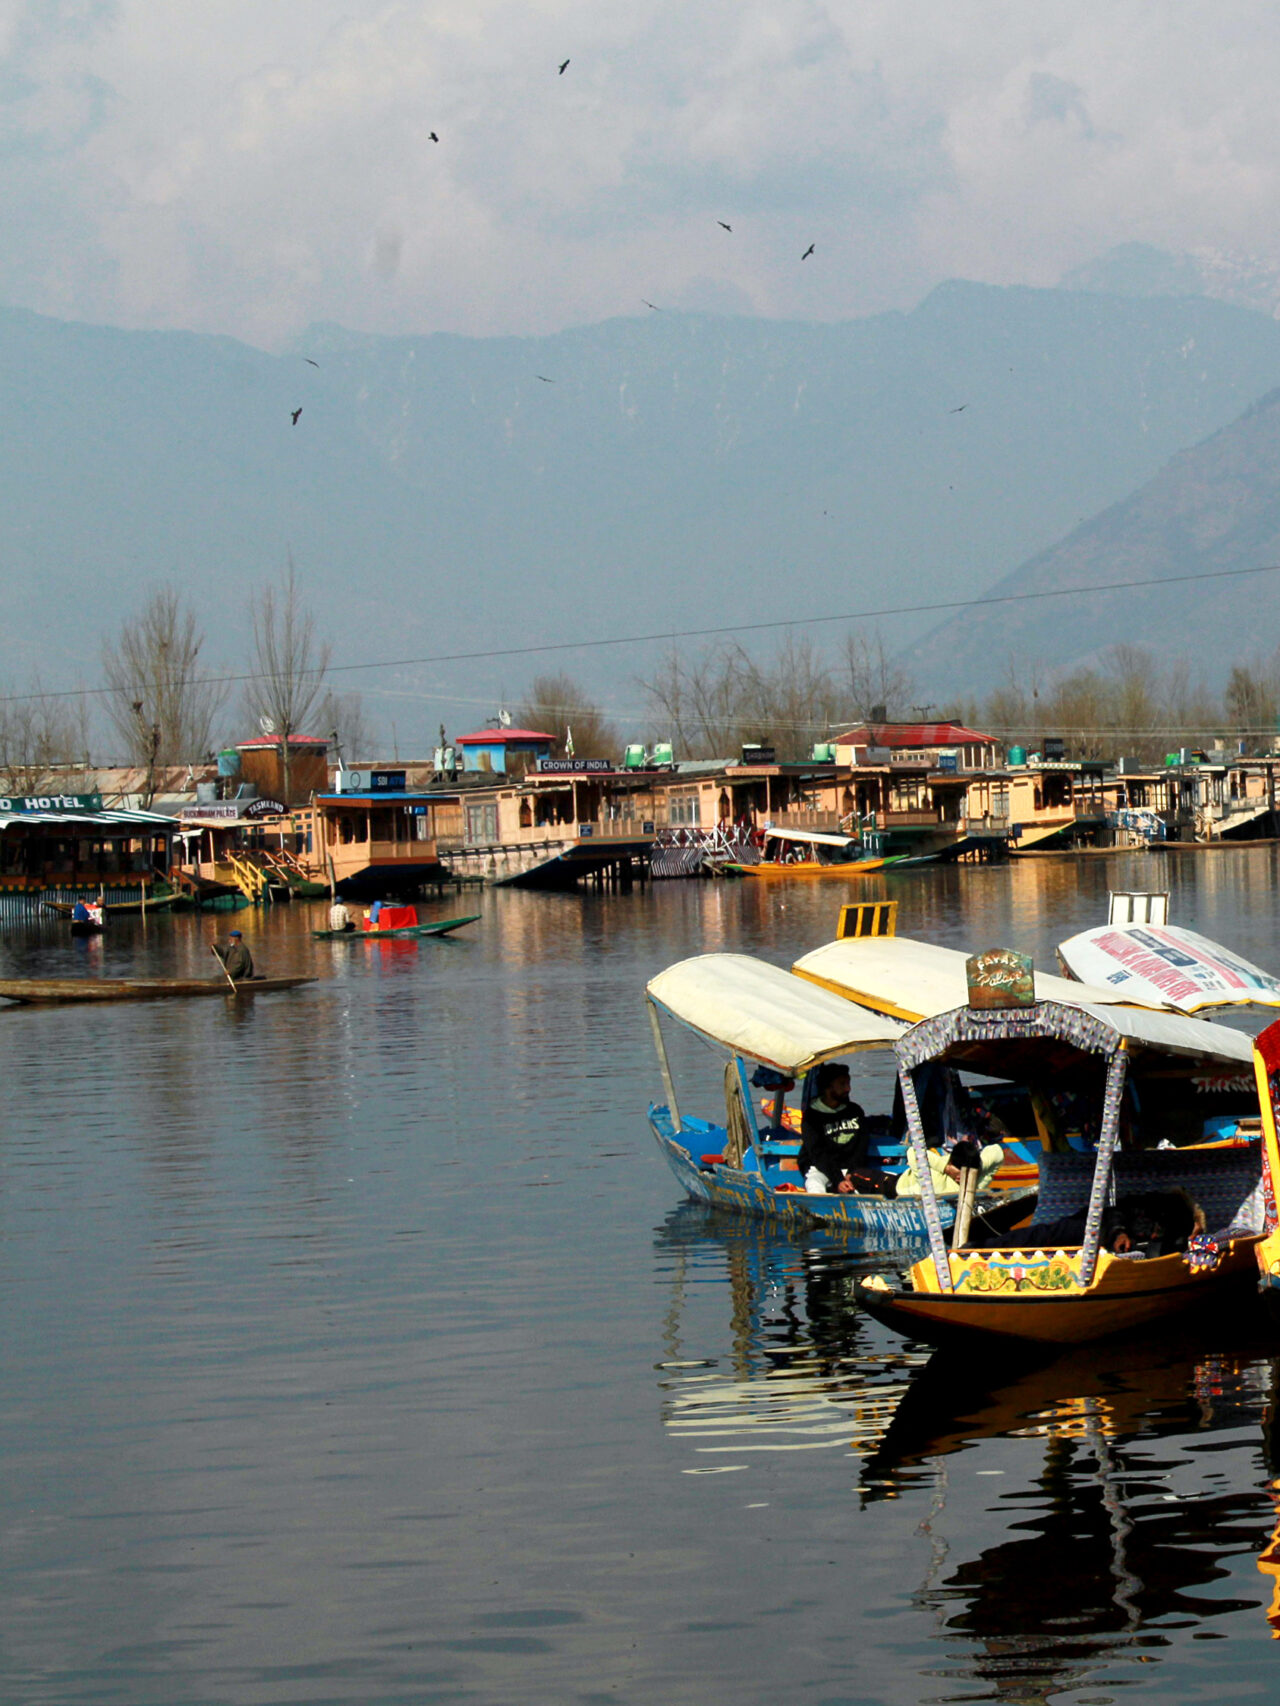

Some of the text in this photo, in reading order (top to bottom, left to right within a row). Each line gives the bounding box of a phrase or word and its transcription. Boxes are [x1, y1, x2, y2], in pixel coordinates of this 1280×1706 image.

[542, 761, 608, 770] CROWN OF INDIA
[24, 796, 85, 810] HOTEL
